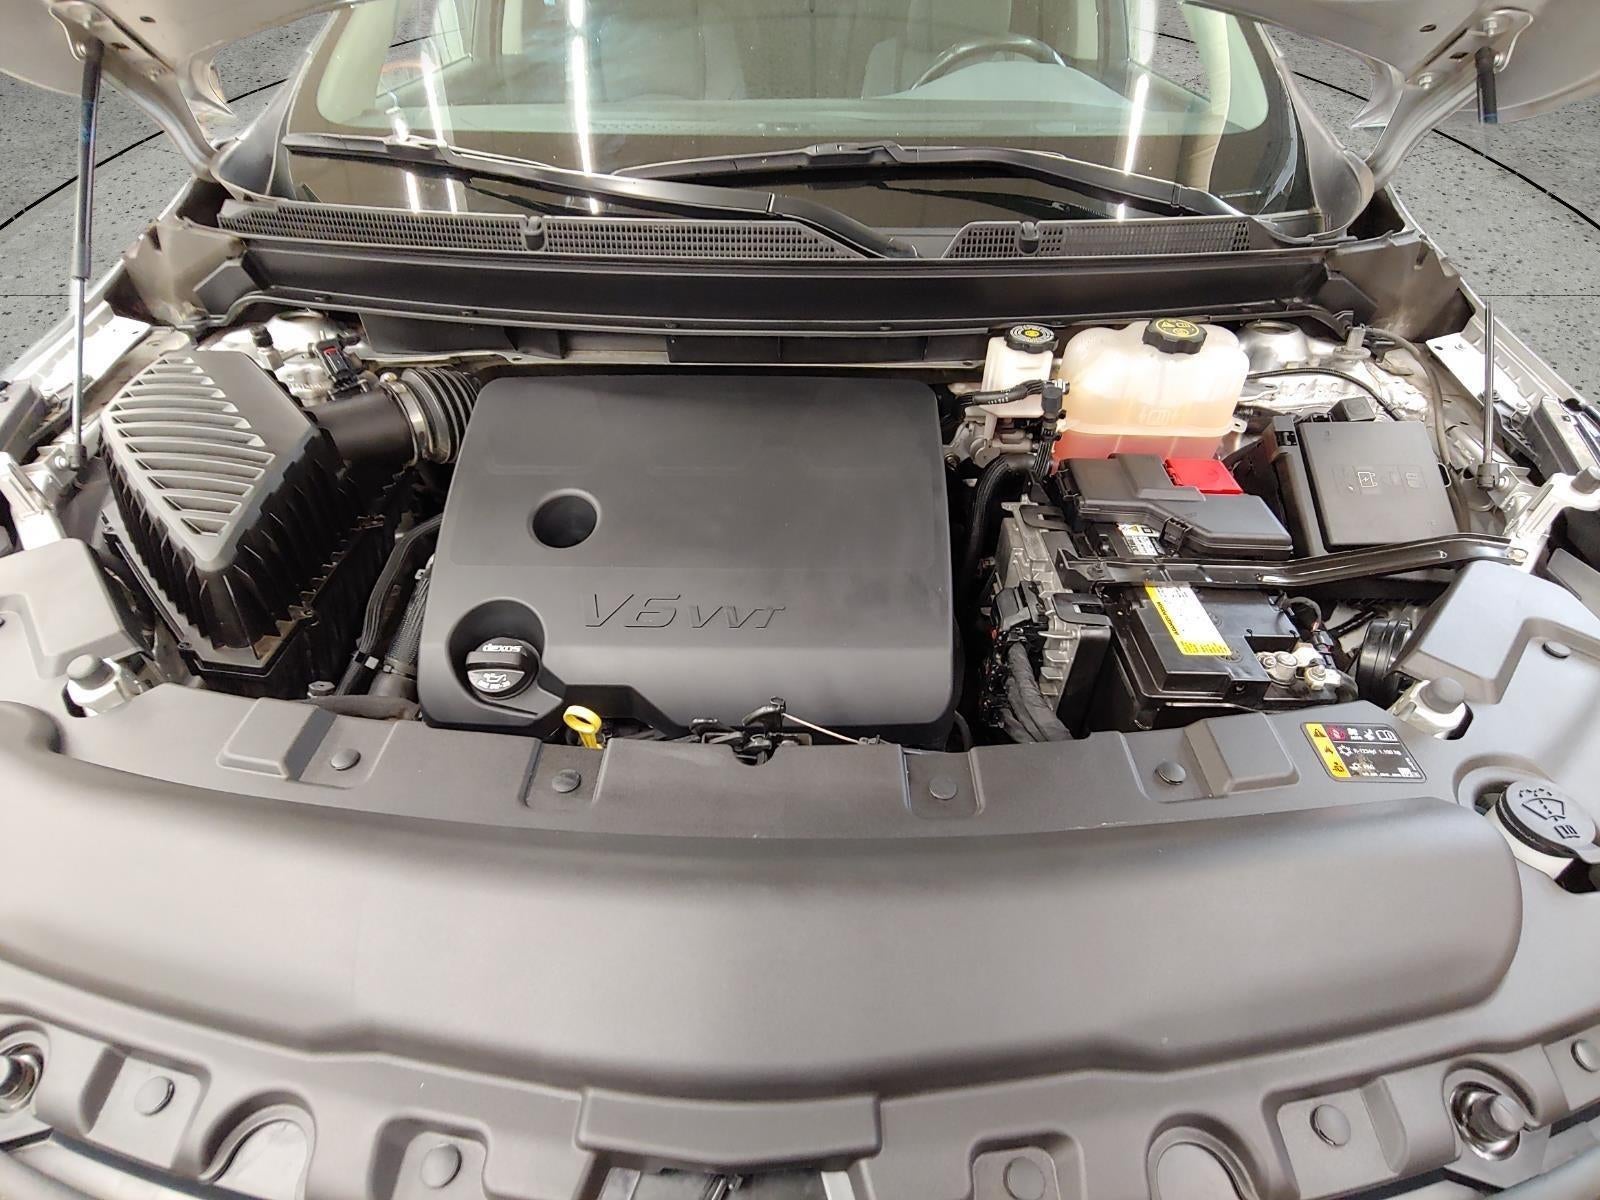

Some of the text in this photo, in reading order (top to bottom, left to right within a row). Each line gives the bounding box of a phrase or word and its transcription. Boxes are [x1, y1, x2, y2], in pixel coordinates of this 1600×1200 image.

[585, 593, 786, 629] V6 VVT
[482, 643, 522, 653] dexos
